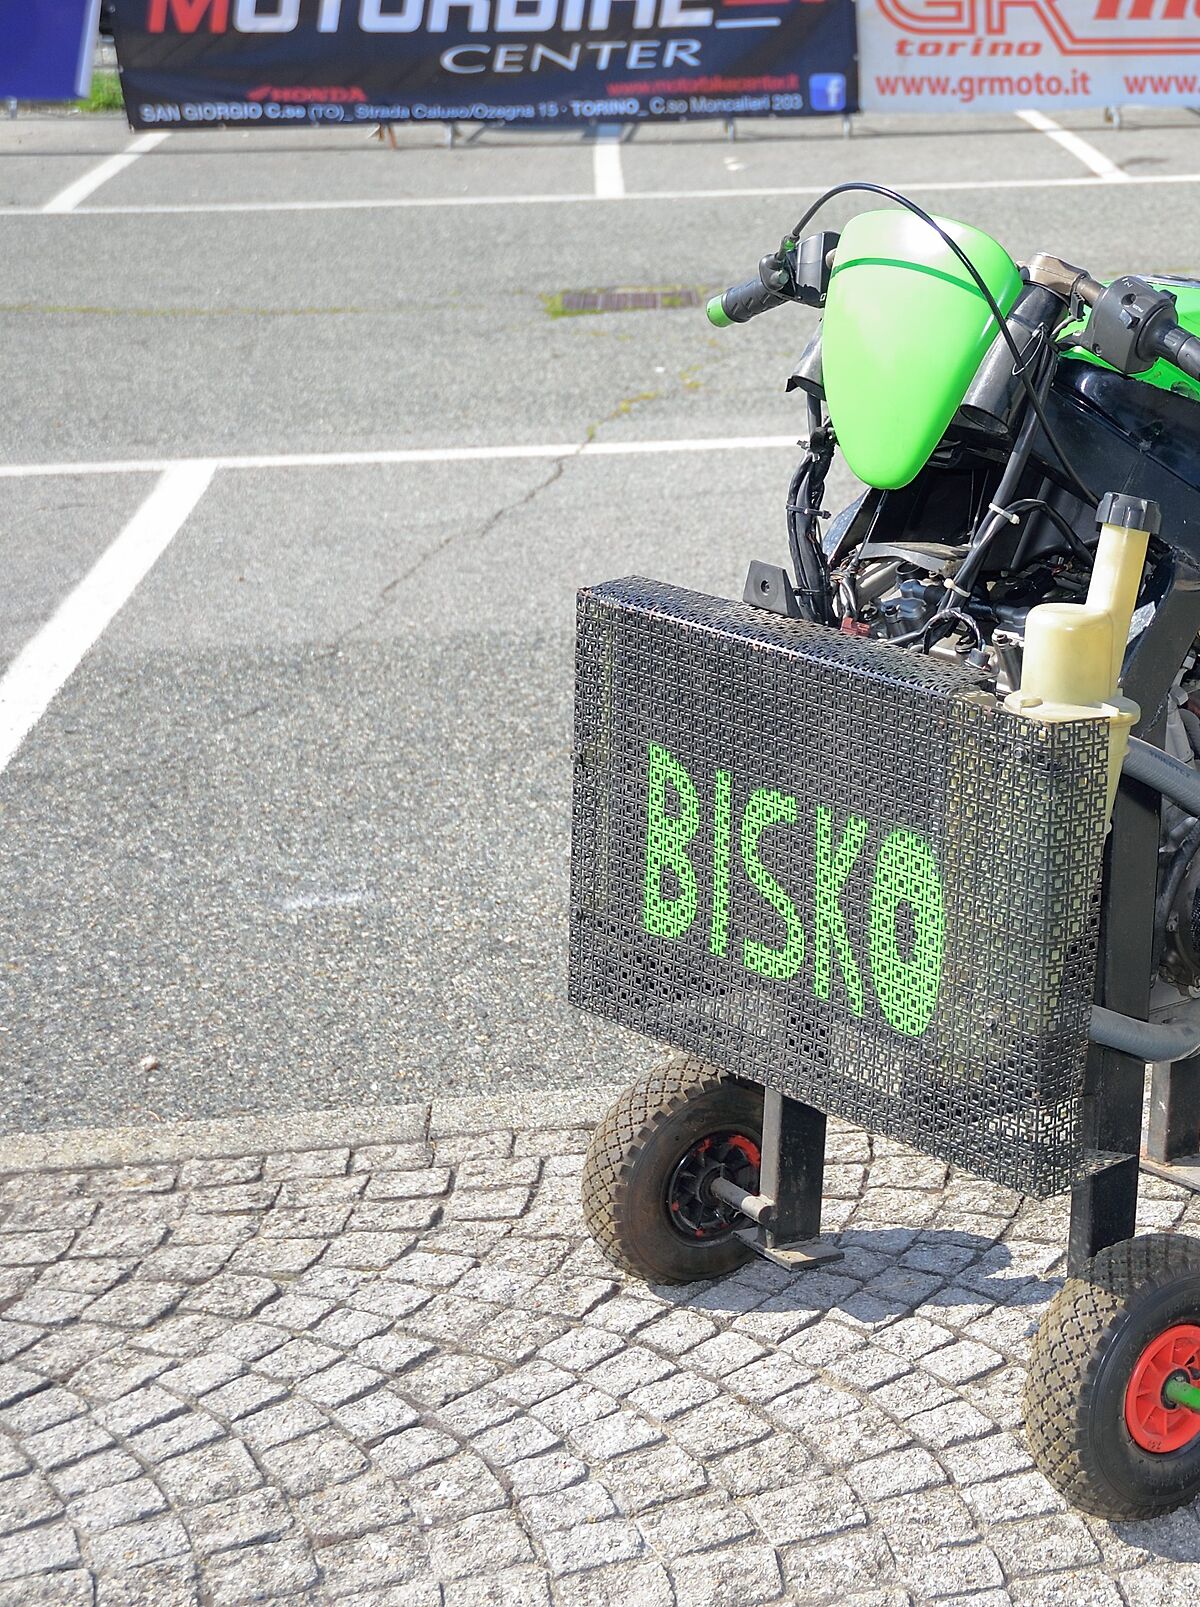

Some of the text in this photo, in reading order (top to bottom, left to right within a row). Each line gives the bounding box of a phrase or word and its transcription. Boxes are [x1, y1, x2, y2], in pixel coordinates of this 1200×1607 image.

[440, 39, 702, 73] CENTER
[896, 38, 1042, 56] torino
[271, 86, 367, 102] HONDA
[875, 69, 1091, 103] www.grmoto.it
[139, 104, 181, 122] SAN
[181, 101, 263, 121] GIORGIO
[354, 103, 410, 119] Strada
[649, 96, 688, 114] C.so
[689, 95, 770, 114] Moncalieri
[642, 741, 947, 1037] BISKO
